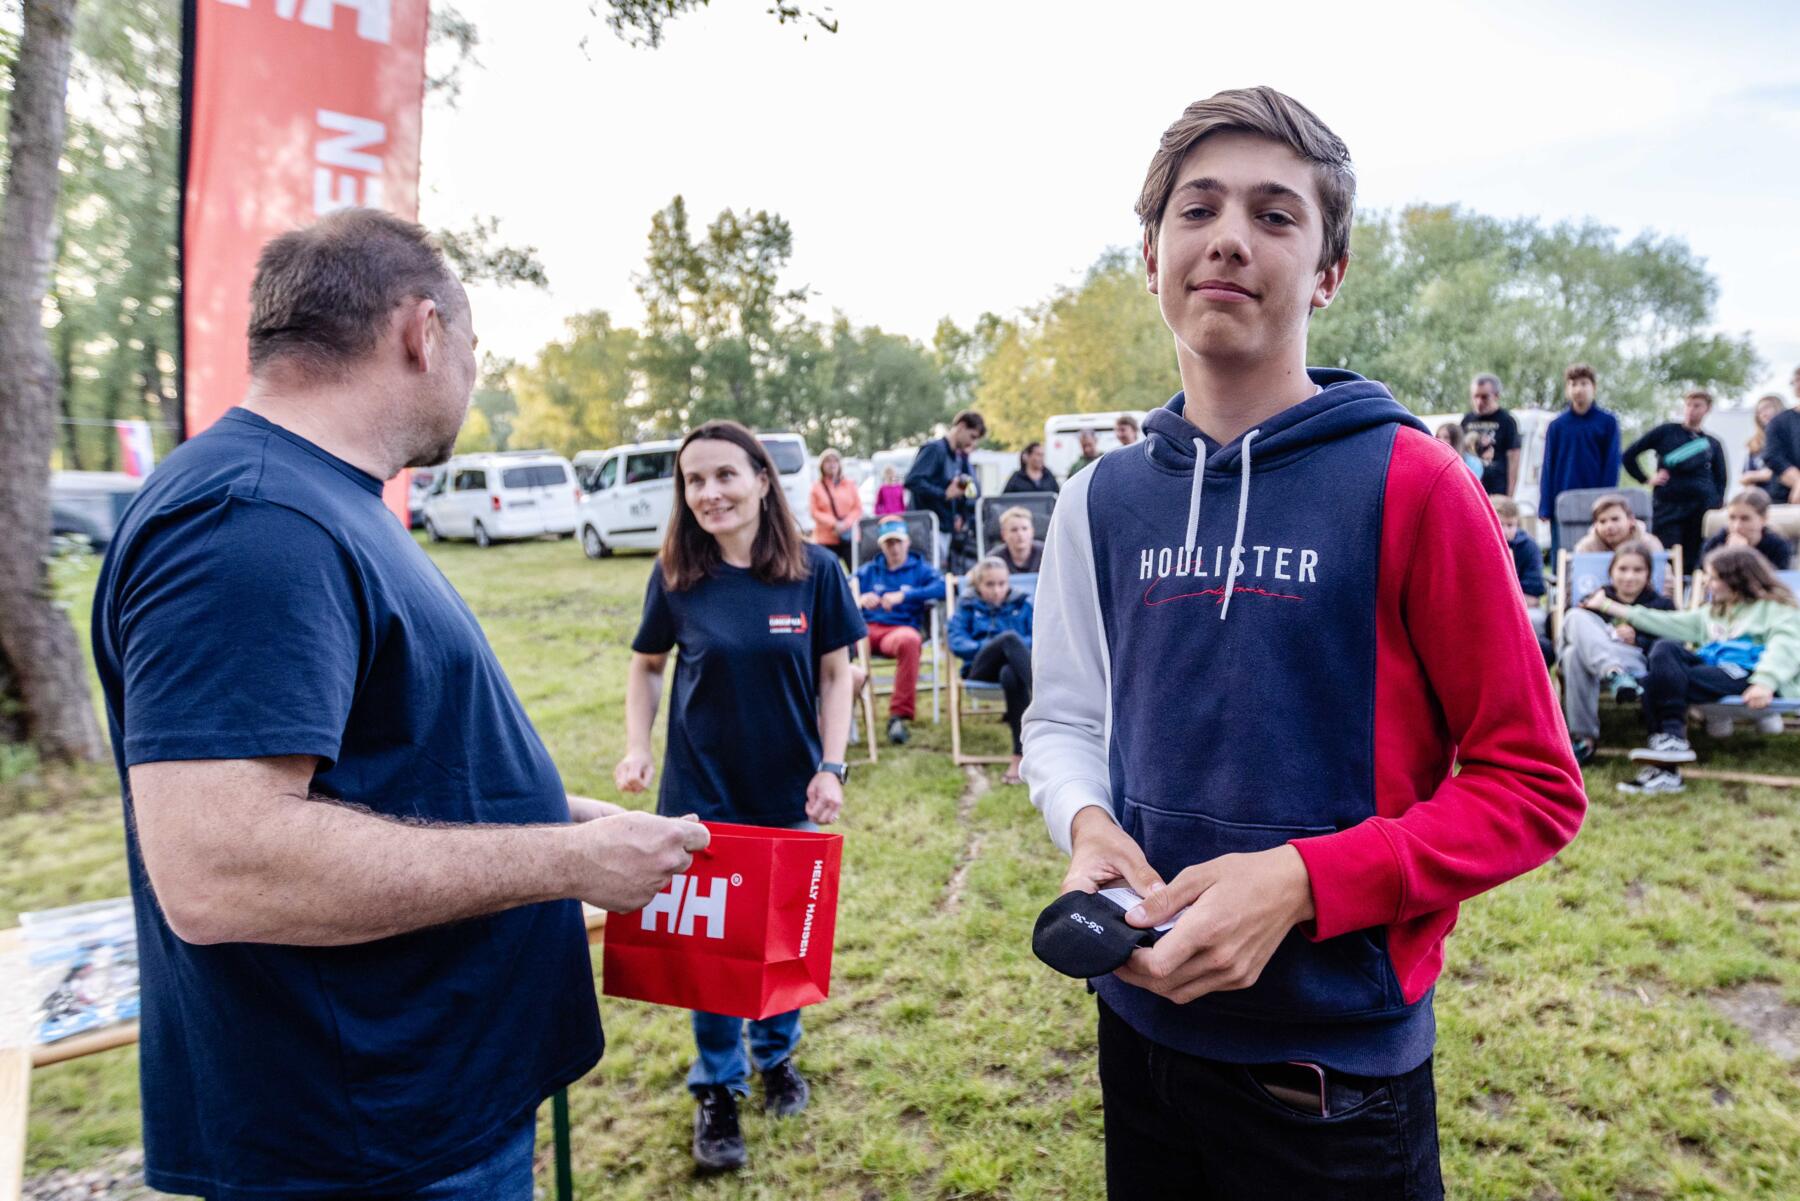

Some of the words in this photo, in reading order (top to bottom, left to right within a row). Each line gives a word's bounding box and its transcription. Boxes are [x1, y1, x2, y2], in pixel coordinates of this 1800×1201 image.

[1140, 546, 1318, 583] HOLLISTER
[809, 860, 823, 900] HELLY
[799, 903, 816, 958] HANSEN
[1070, 912, 1104, 934] 36-39
